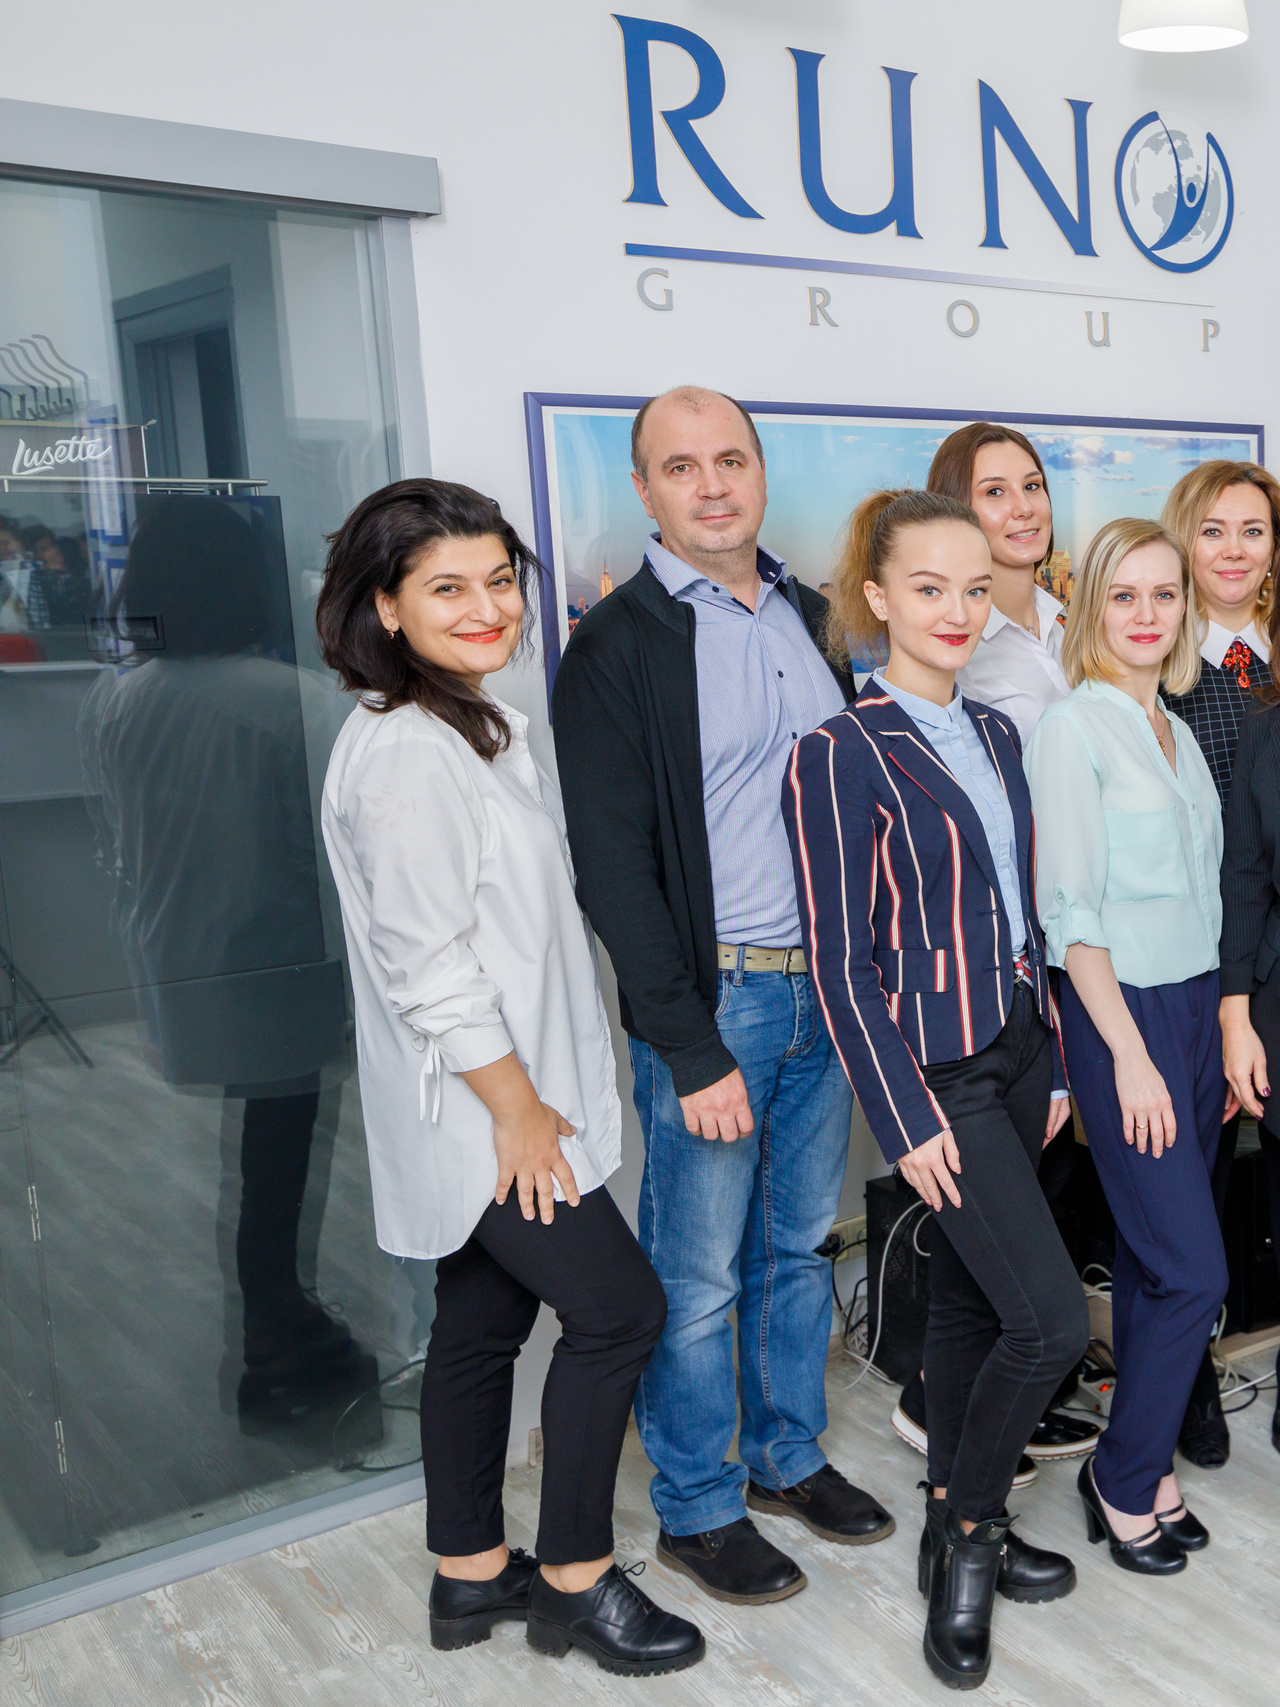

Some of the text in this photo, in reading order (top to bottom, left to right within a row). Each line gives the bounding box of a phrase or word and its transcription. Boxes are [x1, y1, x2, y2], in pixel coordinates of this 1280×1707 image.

[610, 13, 1235, 274] RUNO
[635, 266, 1221, 352] GROUP
[11, 435, 113, 476] Lusette
